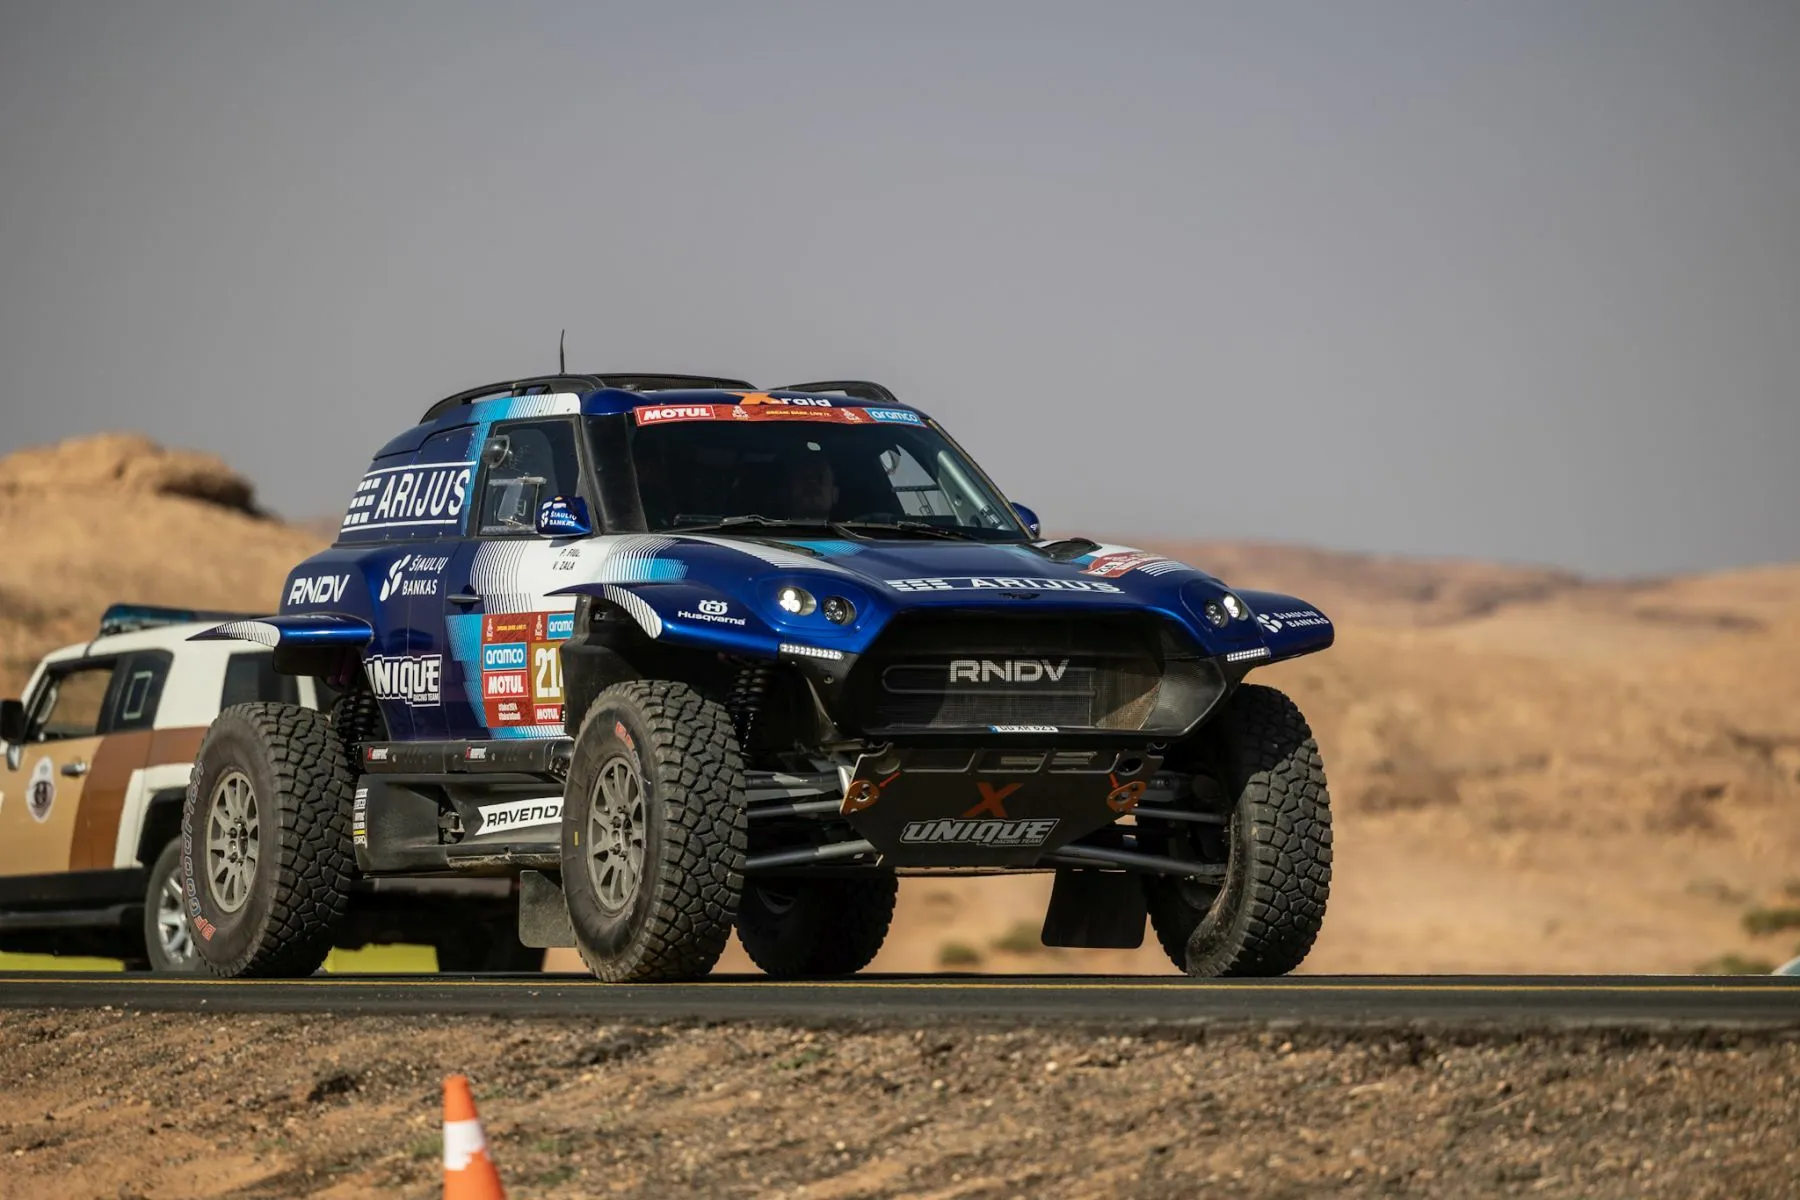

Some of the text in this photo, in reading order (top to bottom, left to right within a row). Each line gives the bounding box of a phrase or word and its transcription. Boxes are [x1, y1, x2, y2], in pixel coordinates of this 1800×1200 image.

[643, 407, 711, 421] MOTUL
[871, 409, 918, 423] aramco
[373, 468, 471, 520] ARIJUS
[549, 519, 576, 527] BANKAS
[408, 554, 449, 575] ŠIAULIŲ
[559, 560, 575, 571] ZALA
[287, 574, 351, 606] RNDV
[402, 579, 438, 596] BANKAS
[969, 577, 1122, 593] ARIJUS
[677, 610, 747, 627] Husqvarna
[1286, 617, 1330, 628] BANKAS
[485, 647, 524, 665] aramco
[535, 647, 564, 698] 21
[949, 659, 1071, 683] RNDV
[487, 674, 524, 695] MOTUL
[427, 692, 440, 702] TEAM
[536, 707, 560, 720] MOTUL
[486, 804, 564, 828] RAVENO
[902, 820, 1054, 844] UNIQUE
